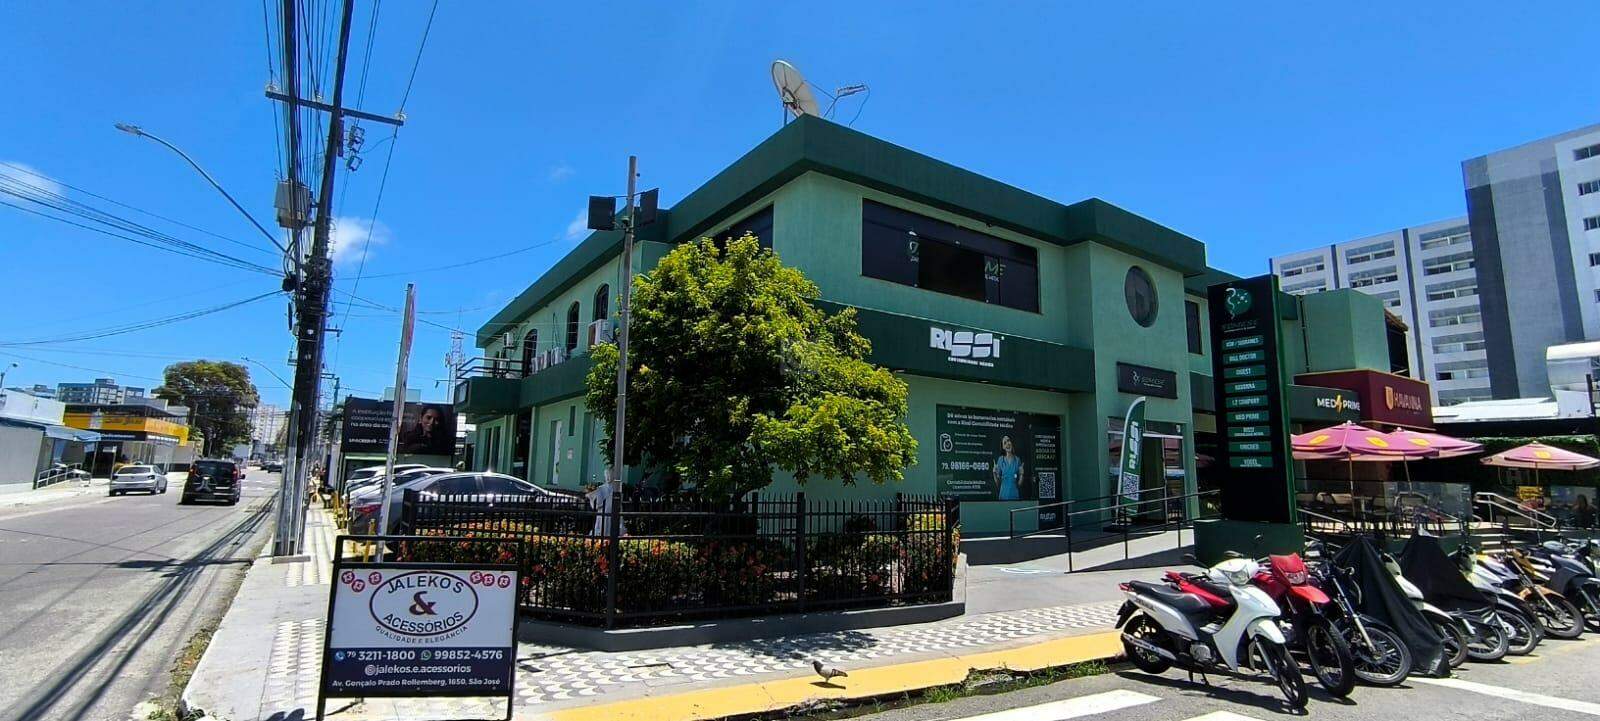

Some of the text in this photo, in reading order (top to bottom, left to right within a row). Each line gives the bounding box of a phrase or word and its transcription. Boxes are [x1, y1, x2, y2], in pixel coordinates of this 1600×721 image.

[930, 327, 1000, 358] RISSI
[1316, 397, 1361, 411] MED PRIME
[1393, 392, 1422, 411] HAVANNA
[1128, 421, 1142, 470] RISSI
[409, 590, 438, 616] &
[375, 625, 417, 644] QUALIDADE
[358, 650, 416, 661] 3211-1800
[434, 650, 503, 660] 99852-4576
[364, 664, 472, 676] @jalekos.e.acessorios
[345, 679, 376, 688] Gonçalo
[401, 678, 447, 687] Rollemberg,
